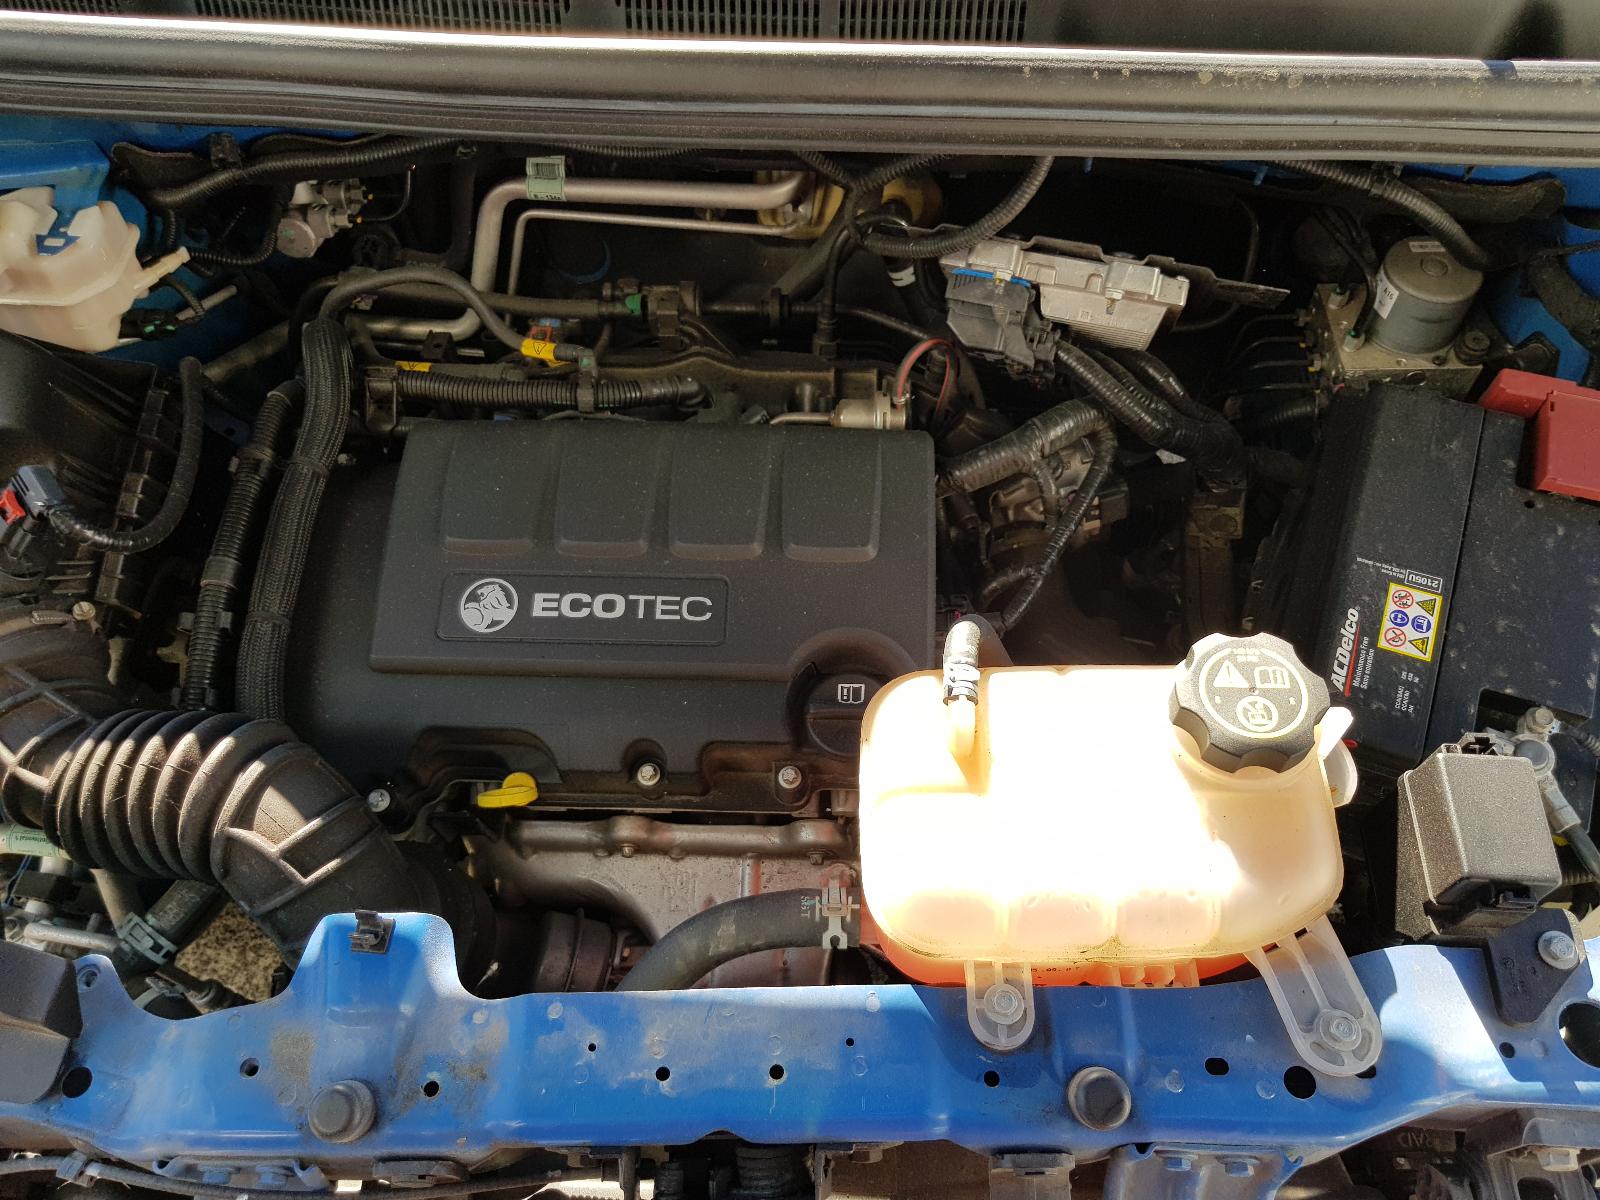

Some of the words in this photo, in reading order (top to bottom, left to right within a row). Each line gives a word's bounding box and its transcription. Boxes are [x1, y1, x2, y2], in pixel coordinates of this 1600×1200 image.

[1408, 573, 1440, 588] 2105U
[532, 592, 713, 622] ECOTEC
[1330, 607, 1359, 692] ACDelco
